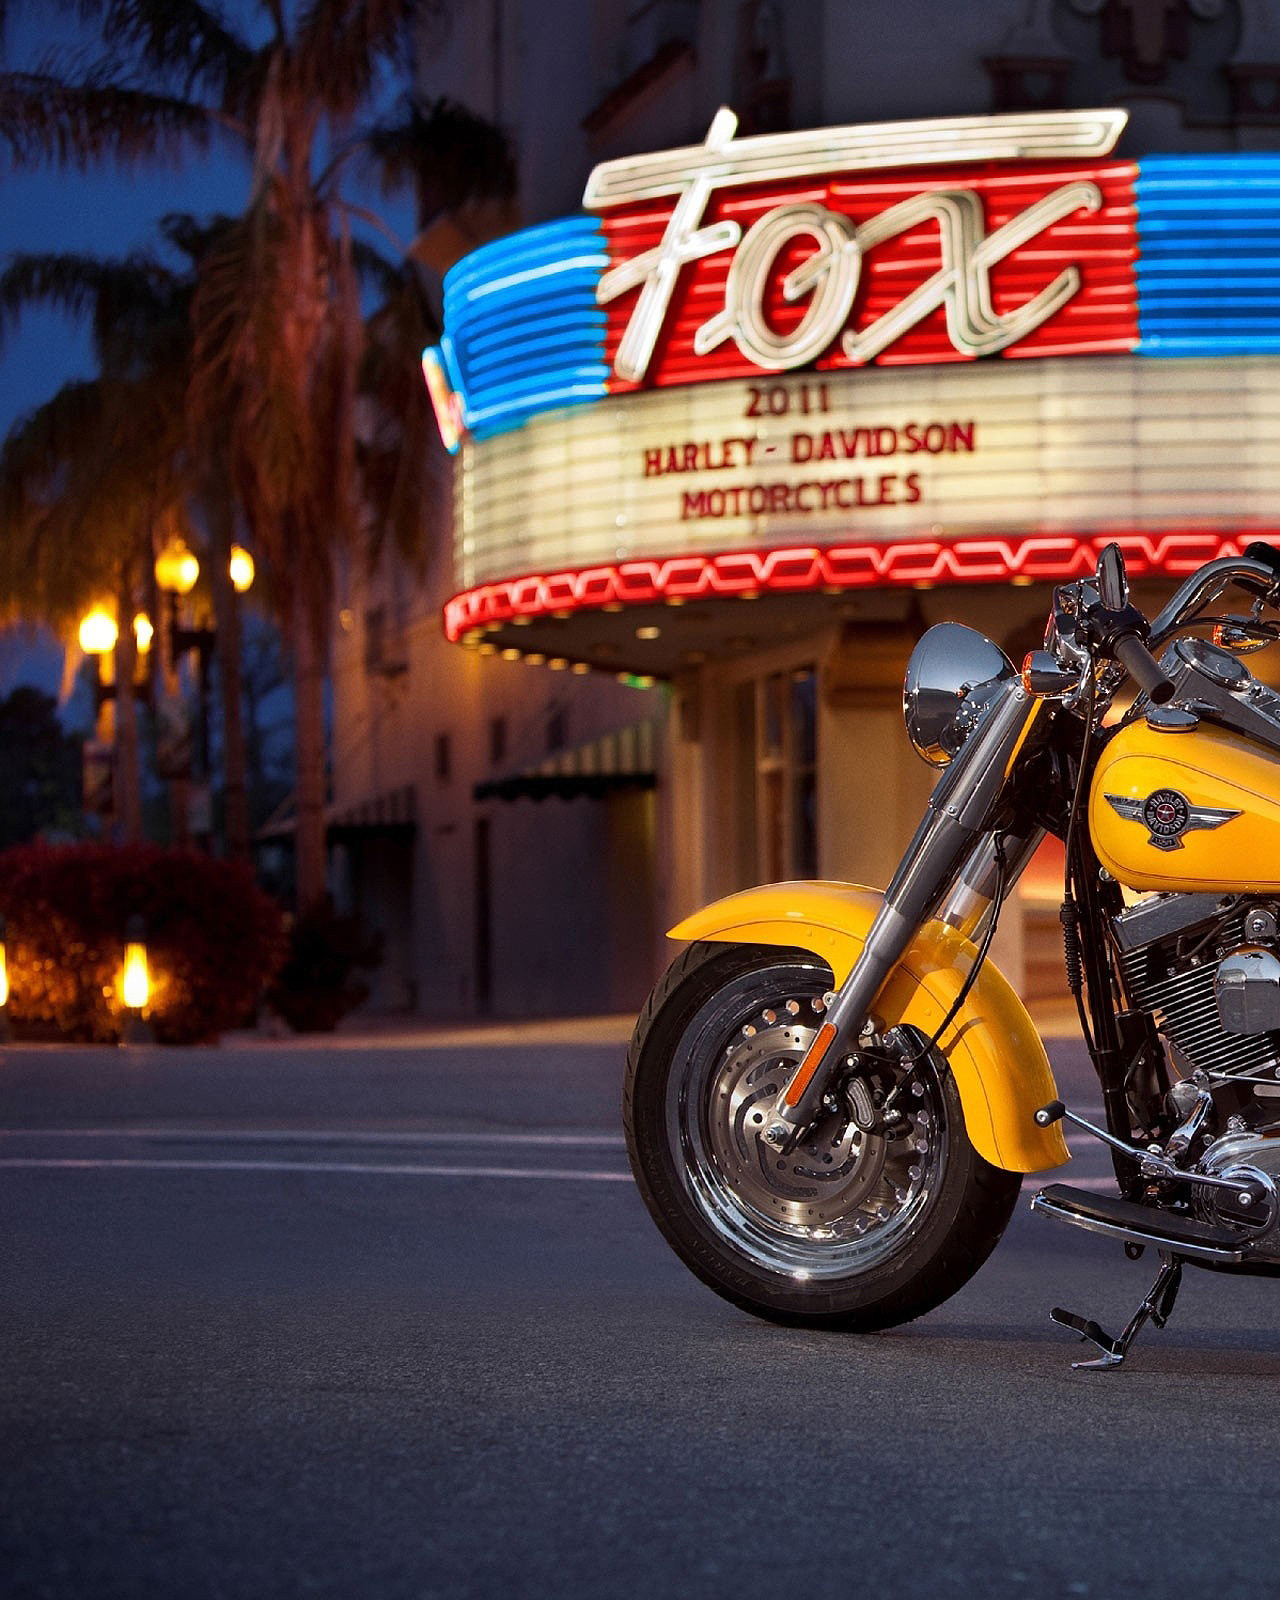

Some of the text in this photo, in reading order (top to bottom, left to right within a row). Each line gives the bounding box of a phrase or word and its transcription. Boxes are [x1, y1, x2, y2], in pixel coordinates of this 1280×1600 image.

[744, 383, 831, 417] 2011
[643, 437, 757, 477] HARLEY
[789, 421, 977, 465] DAVIDSON
[680, 472, 922, 521] MOTORCYCLES
[1150, 793, 1185, 810] HARLEY
[1147, 813, 1186, 833] DAVIDSON
